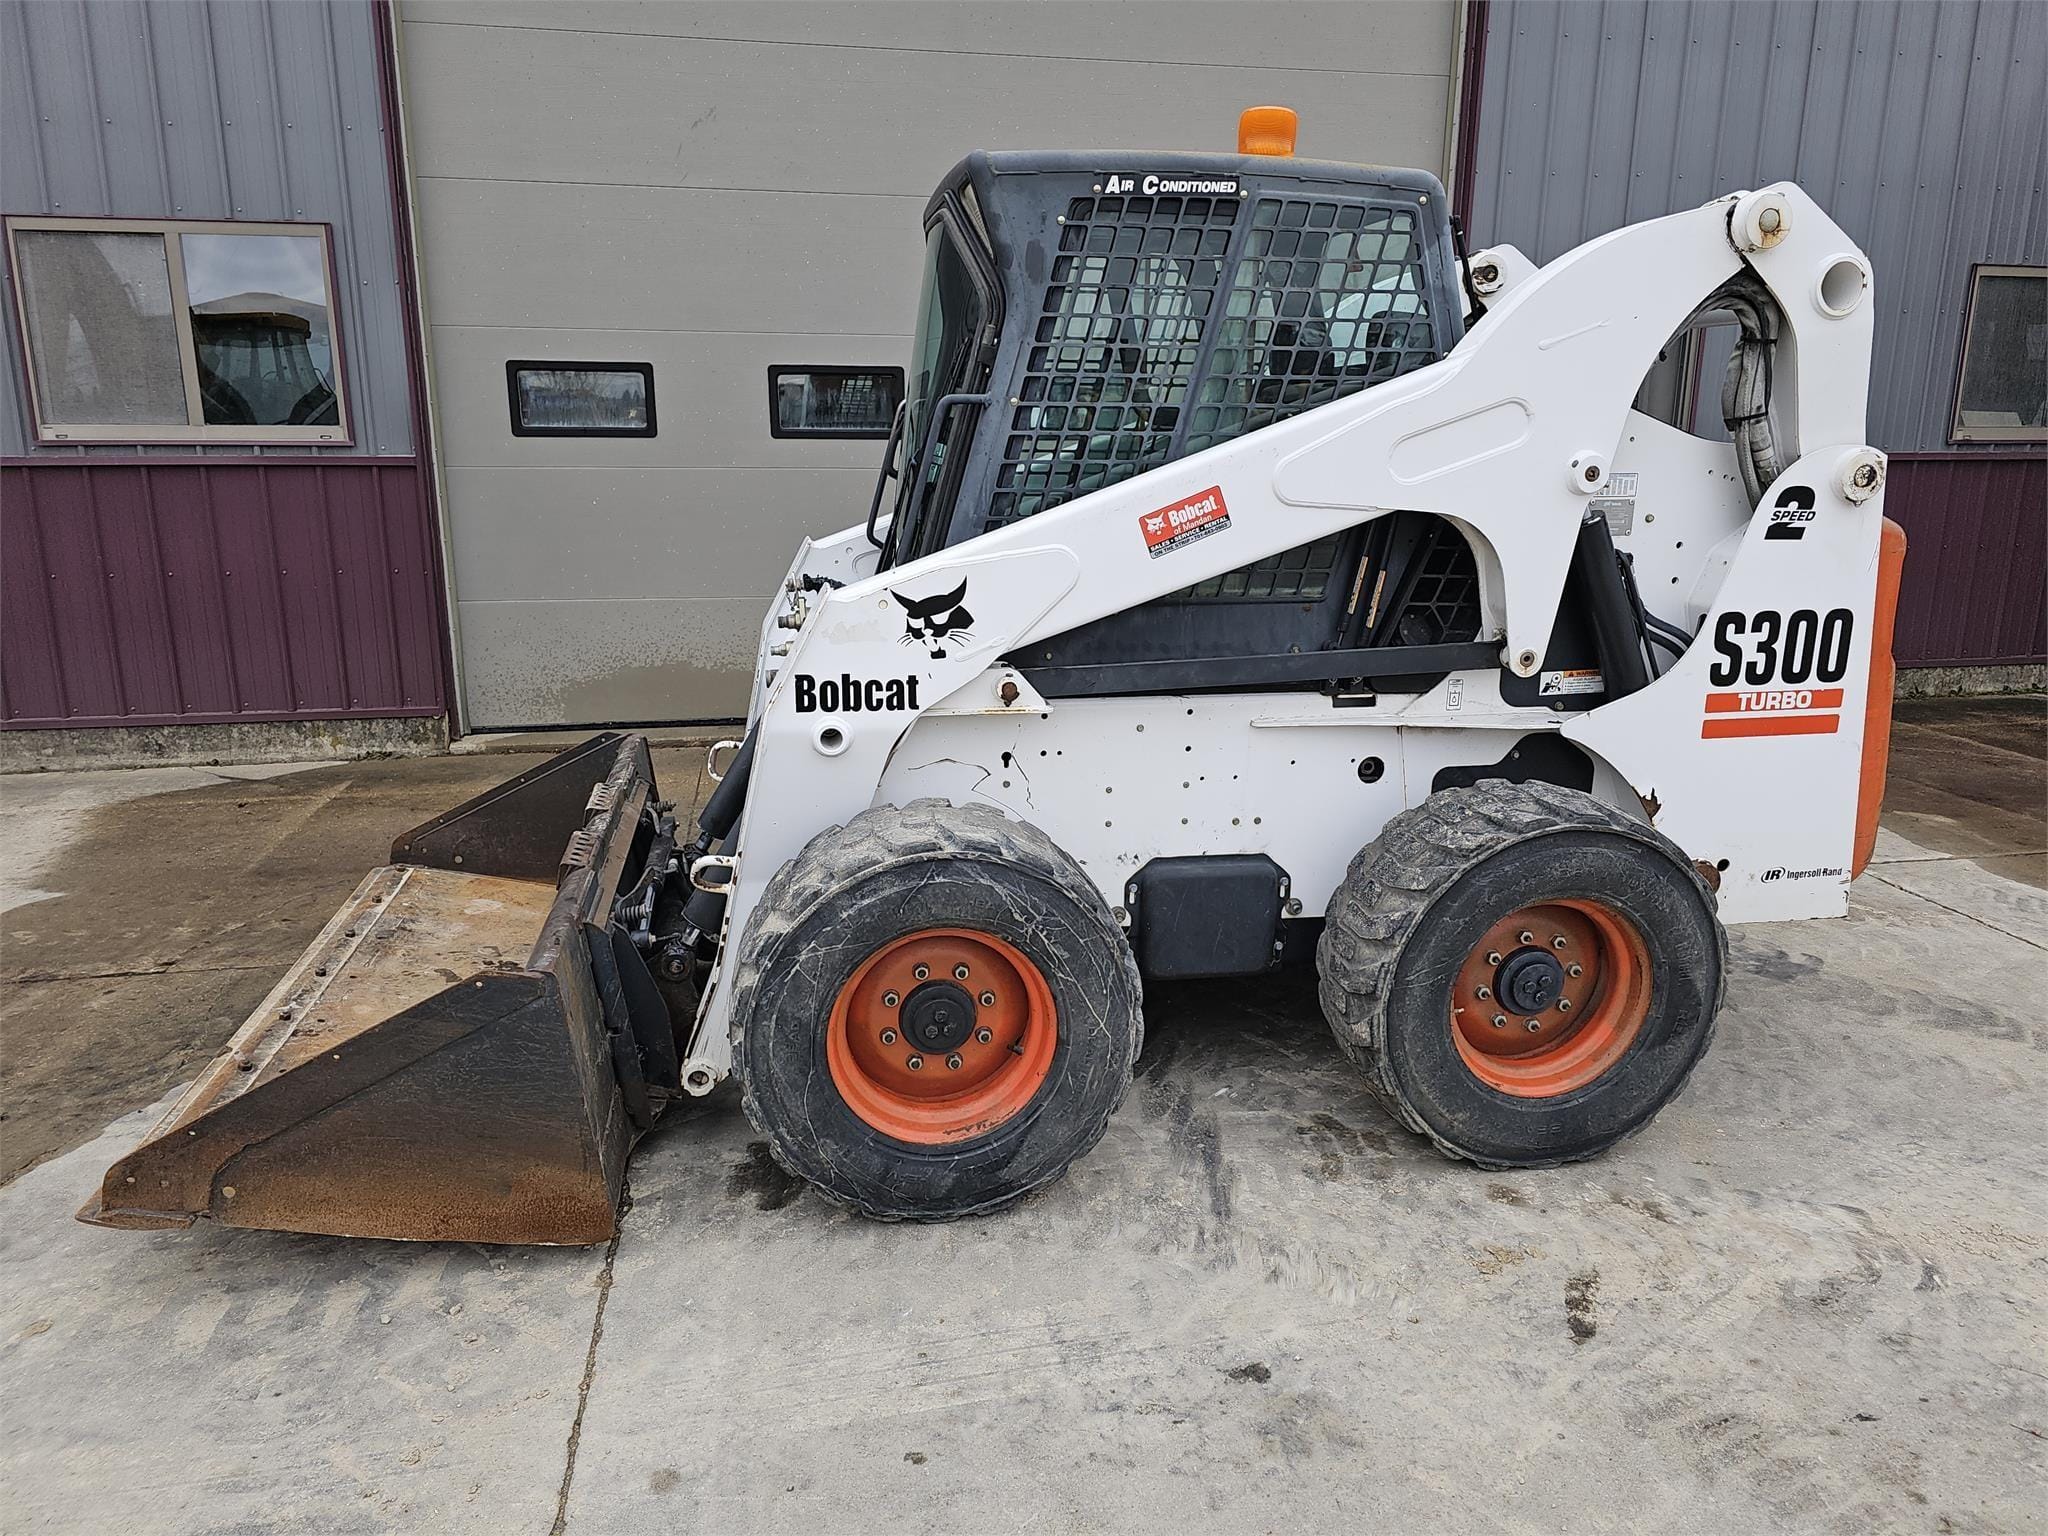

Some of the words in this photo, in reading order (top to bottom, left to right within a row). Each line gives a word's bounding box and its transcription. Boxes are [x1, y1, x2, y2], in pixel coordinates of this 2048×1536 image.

[1167, 495, 1218, 528] Bobcat
[1183, 515, 1213, 531] Mandan
[1764, 485, 1816, 540] 2
[1770, 510, 1817, 522] SPEED
[1150, 539, 1171, 551] SALES
[1174, 527, 1200, 541] SERVICE
[1203, 516, 1228, 529] RENTAL
[1175, 538, 1190, 548] STRIP
[1709, 608, 1854, 687] S300
[794, 673, 920, 713] Bobcat
[1738, 691, 1812, 711] TURBO
